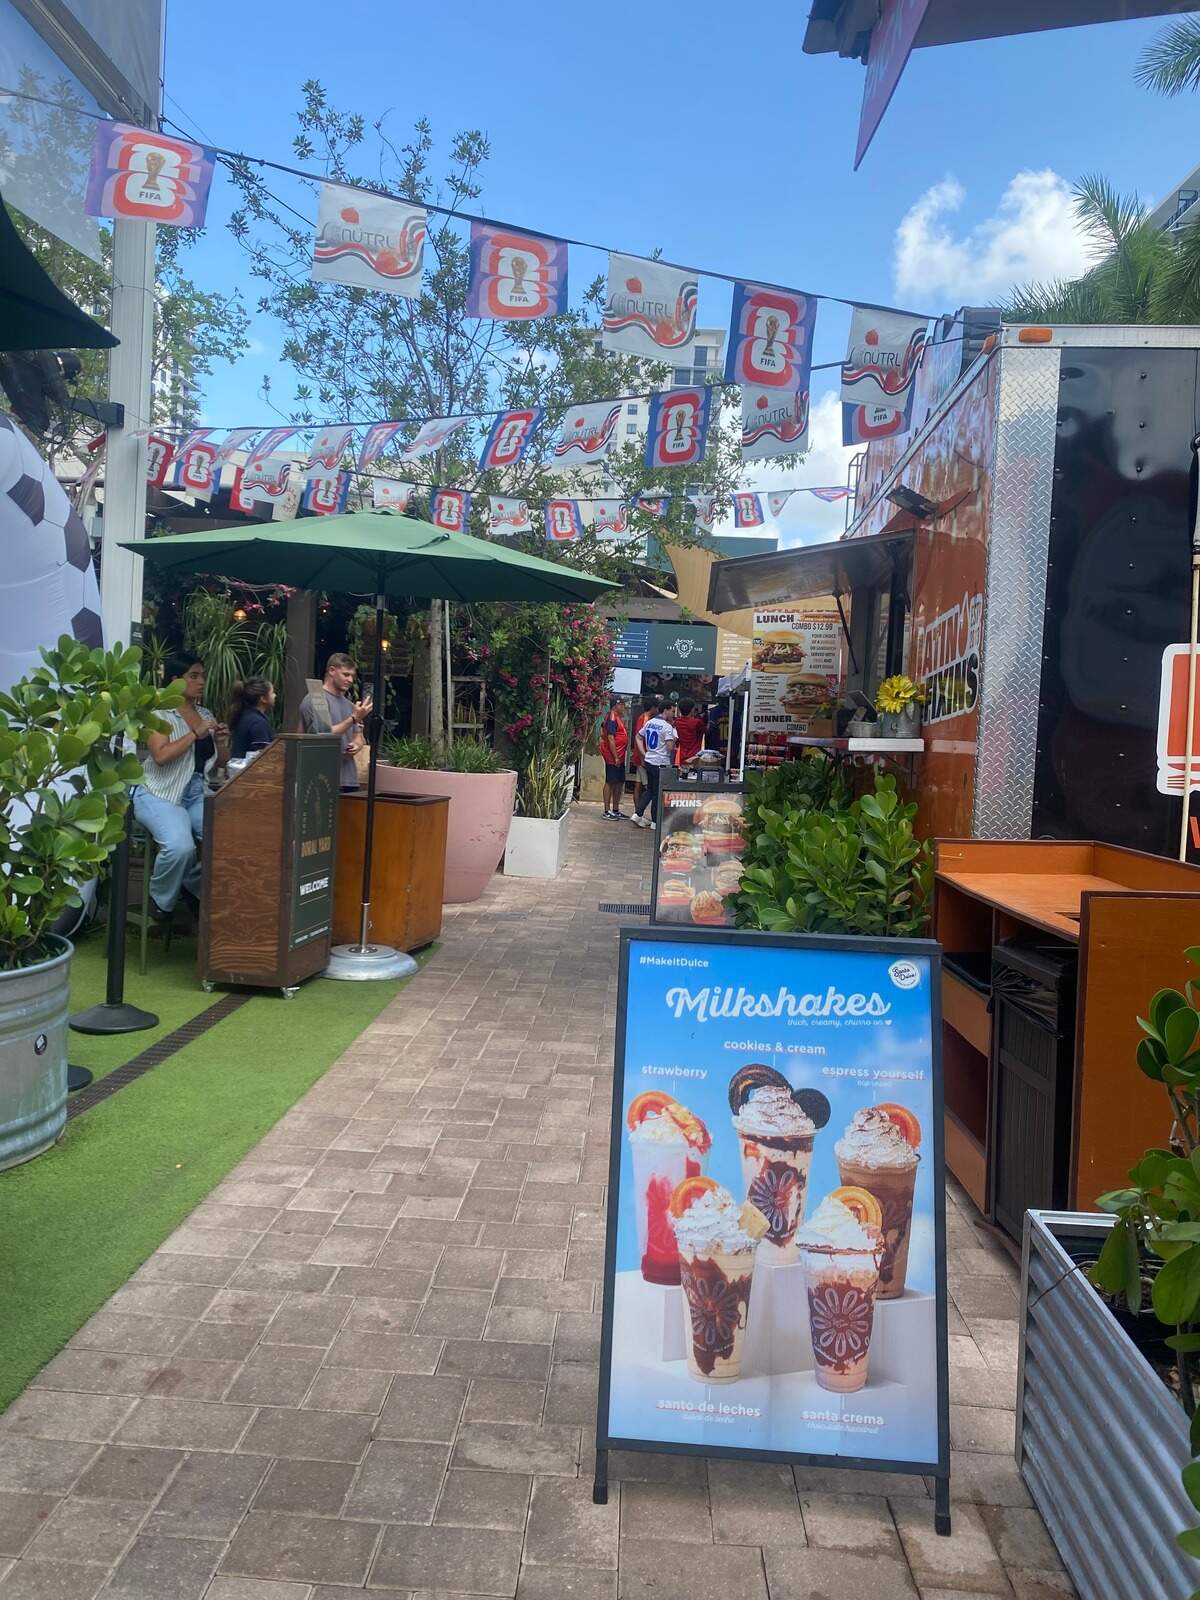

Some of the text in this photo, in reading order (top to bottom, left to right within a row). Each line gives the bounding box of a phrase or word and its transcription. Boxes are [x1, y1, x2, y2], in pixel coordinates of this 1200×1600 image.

[139, 191, 161, 200] FIFA
[509, 295, 528, 303] FIFA
[760, 358, 776, 367] FIFA
[873, 413, 887, 422] FIFA
[756, 614, 795, 623] LUNCH
[813, 623, 833, 631] $12.99
[786, 723, 807, 731] COMBO
[646, 729, 659, 749] 10
[670, 799, 702, 807] FIXINS
[299, 877, 329, 896] WELCOME
[639, 956, 709, 968] #MakeItDulce
[665, 986, 892, 1022] Milkshakes
[724, 1040, 826, 1055] cookies & cream
[641, 1064, 708, 1079] strawberry
[822, 1066, 925, 1080] espress yourself
[657, 1400, 761, 1417] santo de leches
[801, 1410, 884, 1425] santa crema
